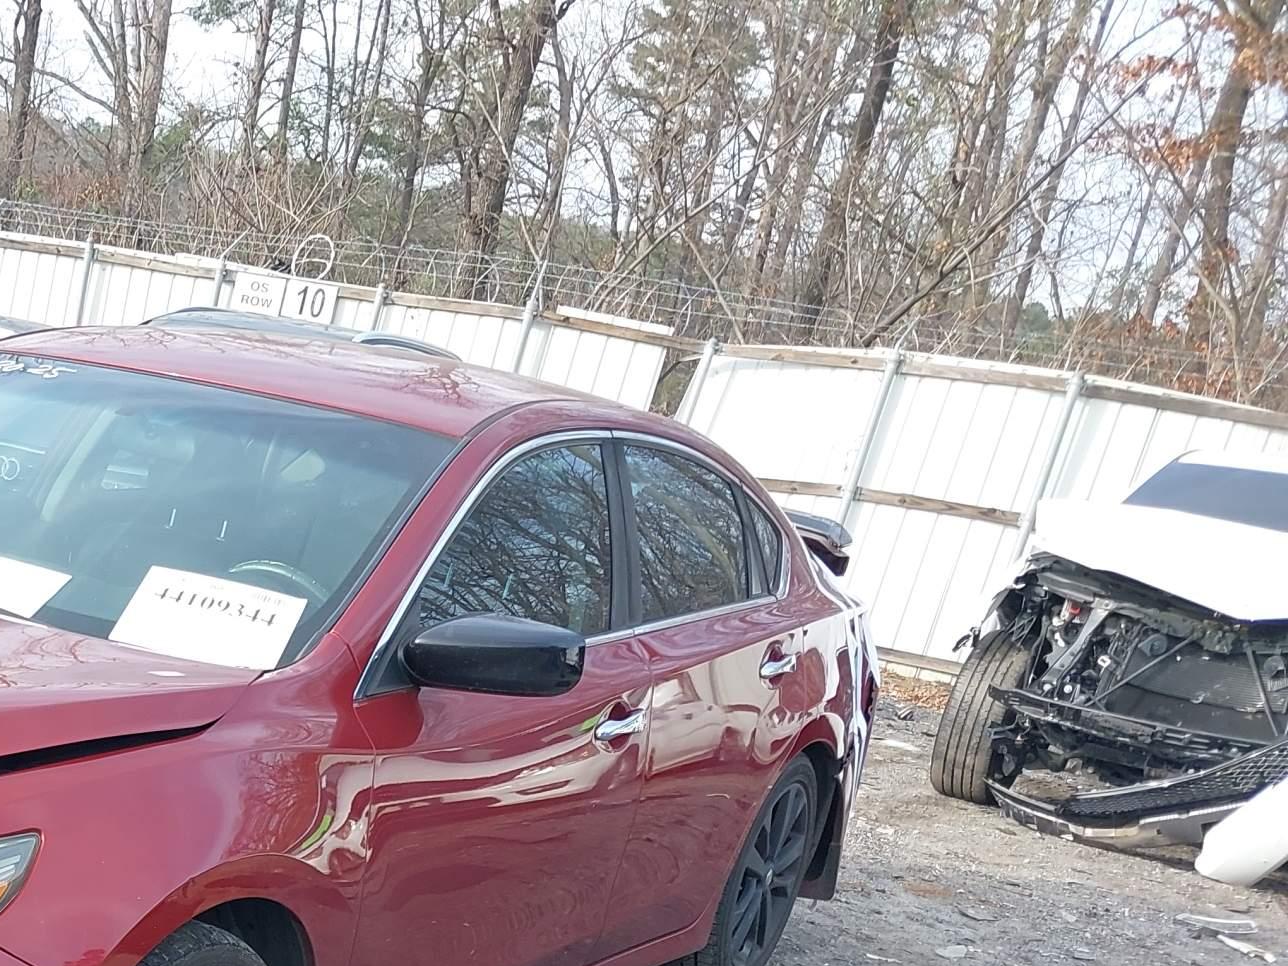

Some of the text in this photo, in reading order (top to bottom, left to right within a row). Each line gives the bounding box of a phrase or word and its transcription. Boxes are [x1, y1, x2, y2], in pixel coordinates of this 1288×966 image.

[250, 281, 270, 293] OS
[240, 294, 273, 309] ROW
[297, 285, 326, 318] 10
[154, 587, 277, 627] 44109344
